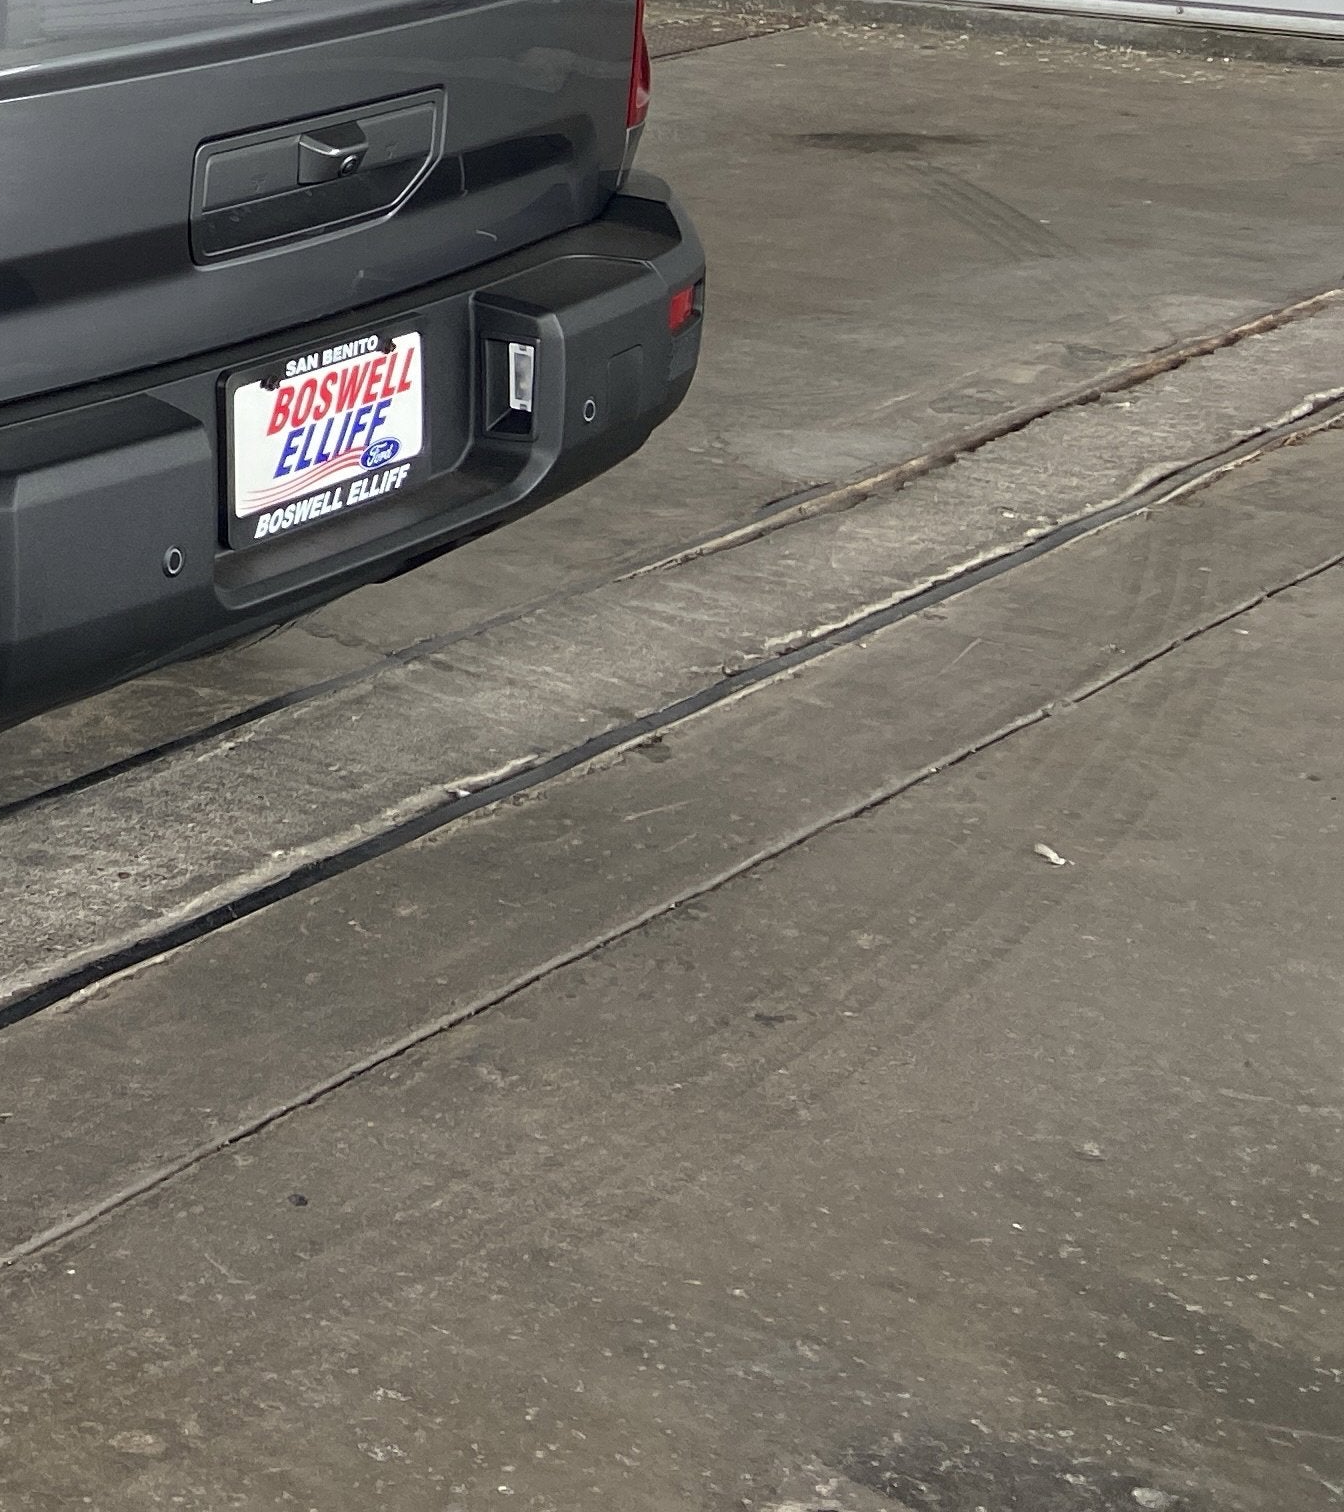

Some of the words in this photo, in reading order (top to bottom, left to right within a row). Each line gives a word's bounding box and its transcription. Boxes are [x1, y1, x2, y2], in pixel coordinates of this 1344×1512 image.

[266, 347, 416, 436] BOSWELL
[285, 353, 319, 377] SAN
[322, 335, 379, 366] BENITO
[273, 398, 393, 479] ELLIFF
[366, 441, 396, 467] Ford
[253, 487, 342, 539] BOSWELL
[346, 463, 411, 506] ELLIFF
